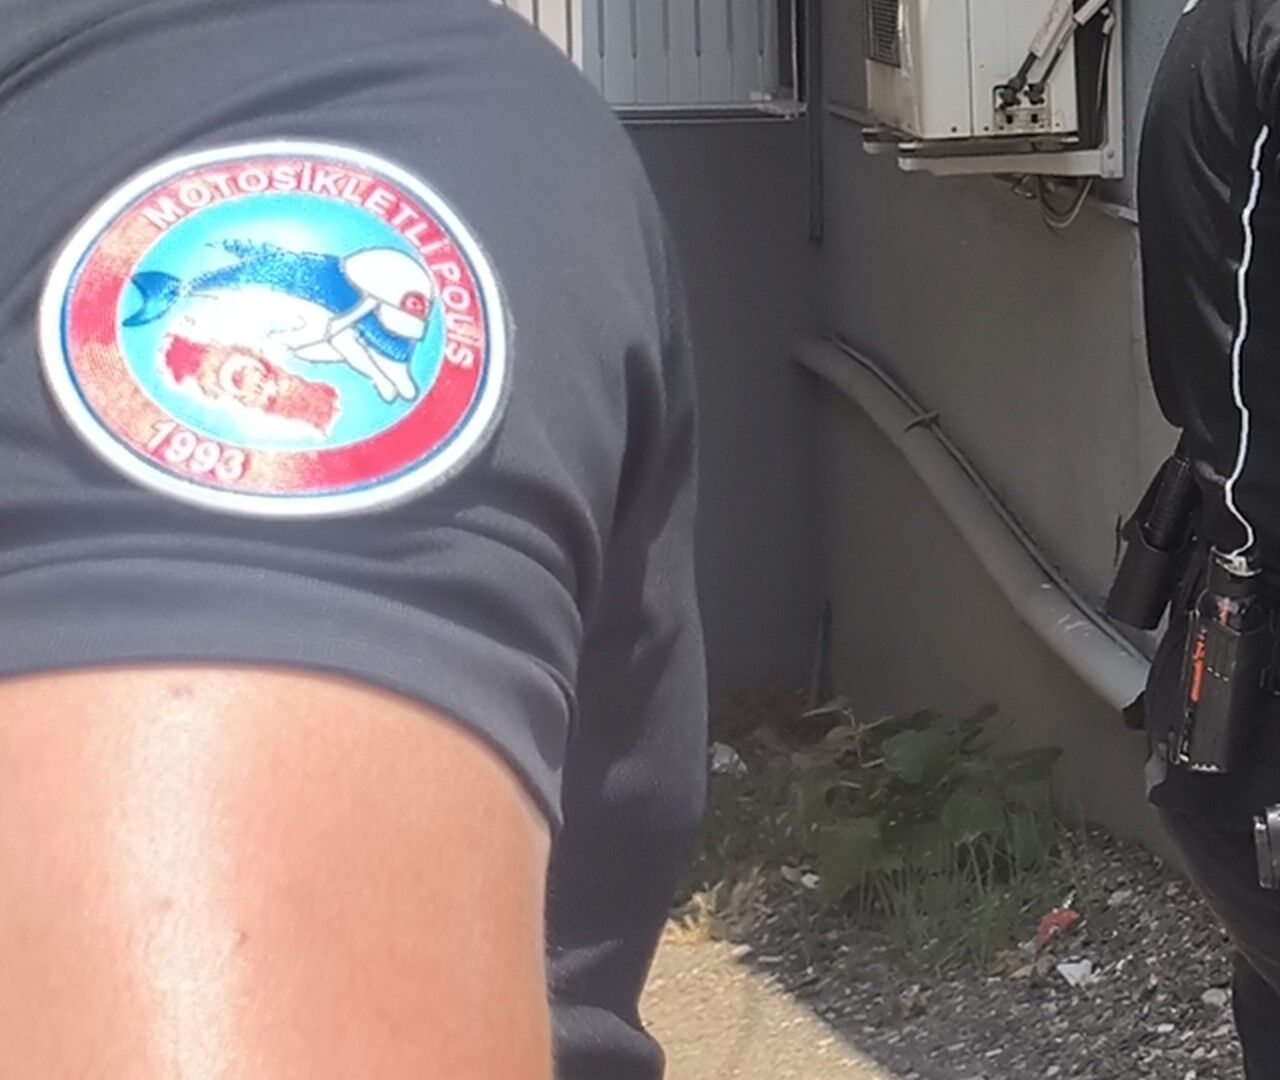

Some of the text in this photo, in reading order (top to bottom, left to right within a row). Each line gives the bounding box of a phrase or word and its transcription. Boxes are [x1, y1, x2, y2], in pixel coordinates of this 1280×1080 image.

[143, 162, 482, 370] MOTOSİKLETLİ POLİS
[147, 420, 246, 481] 1993
